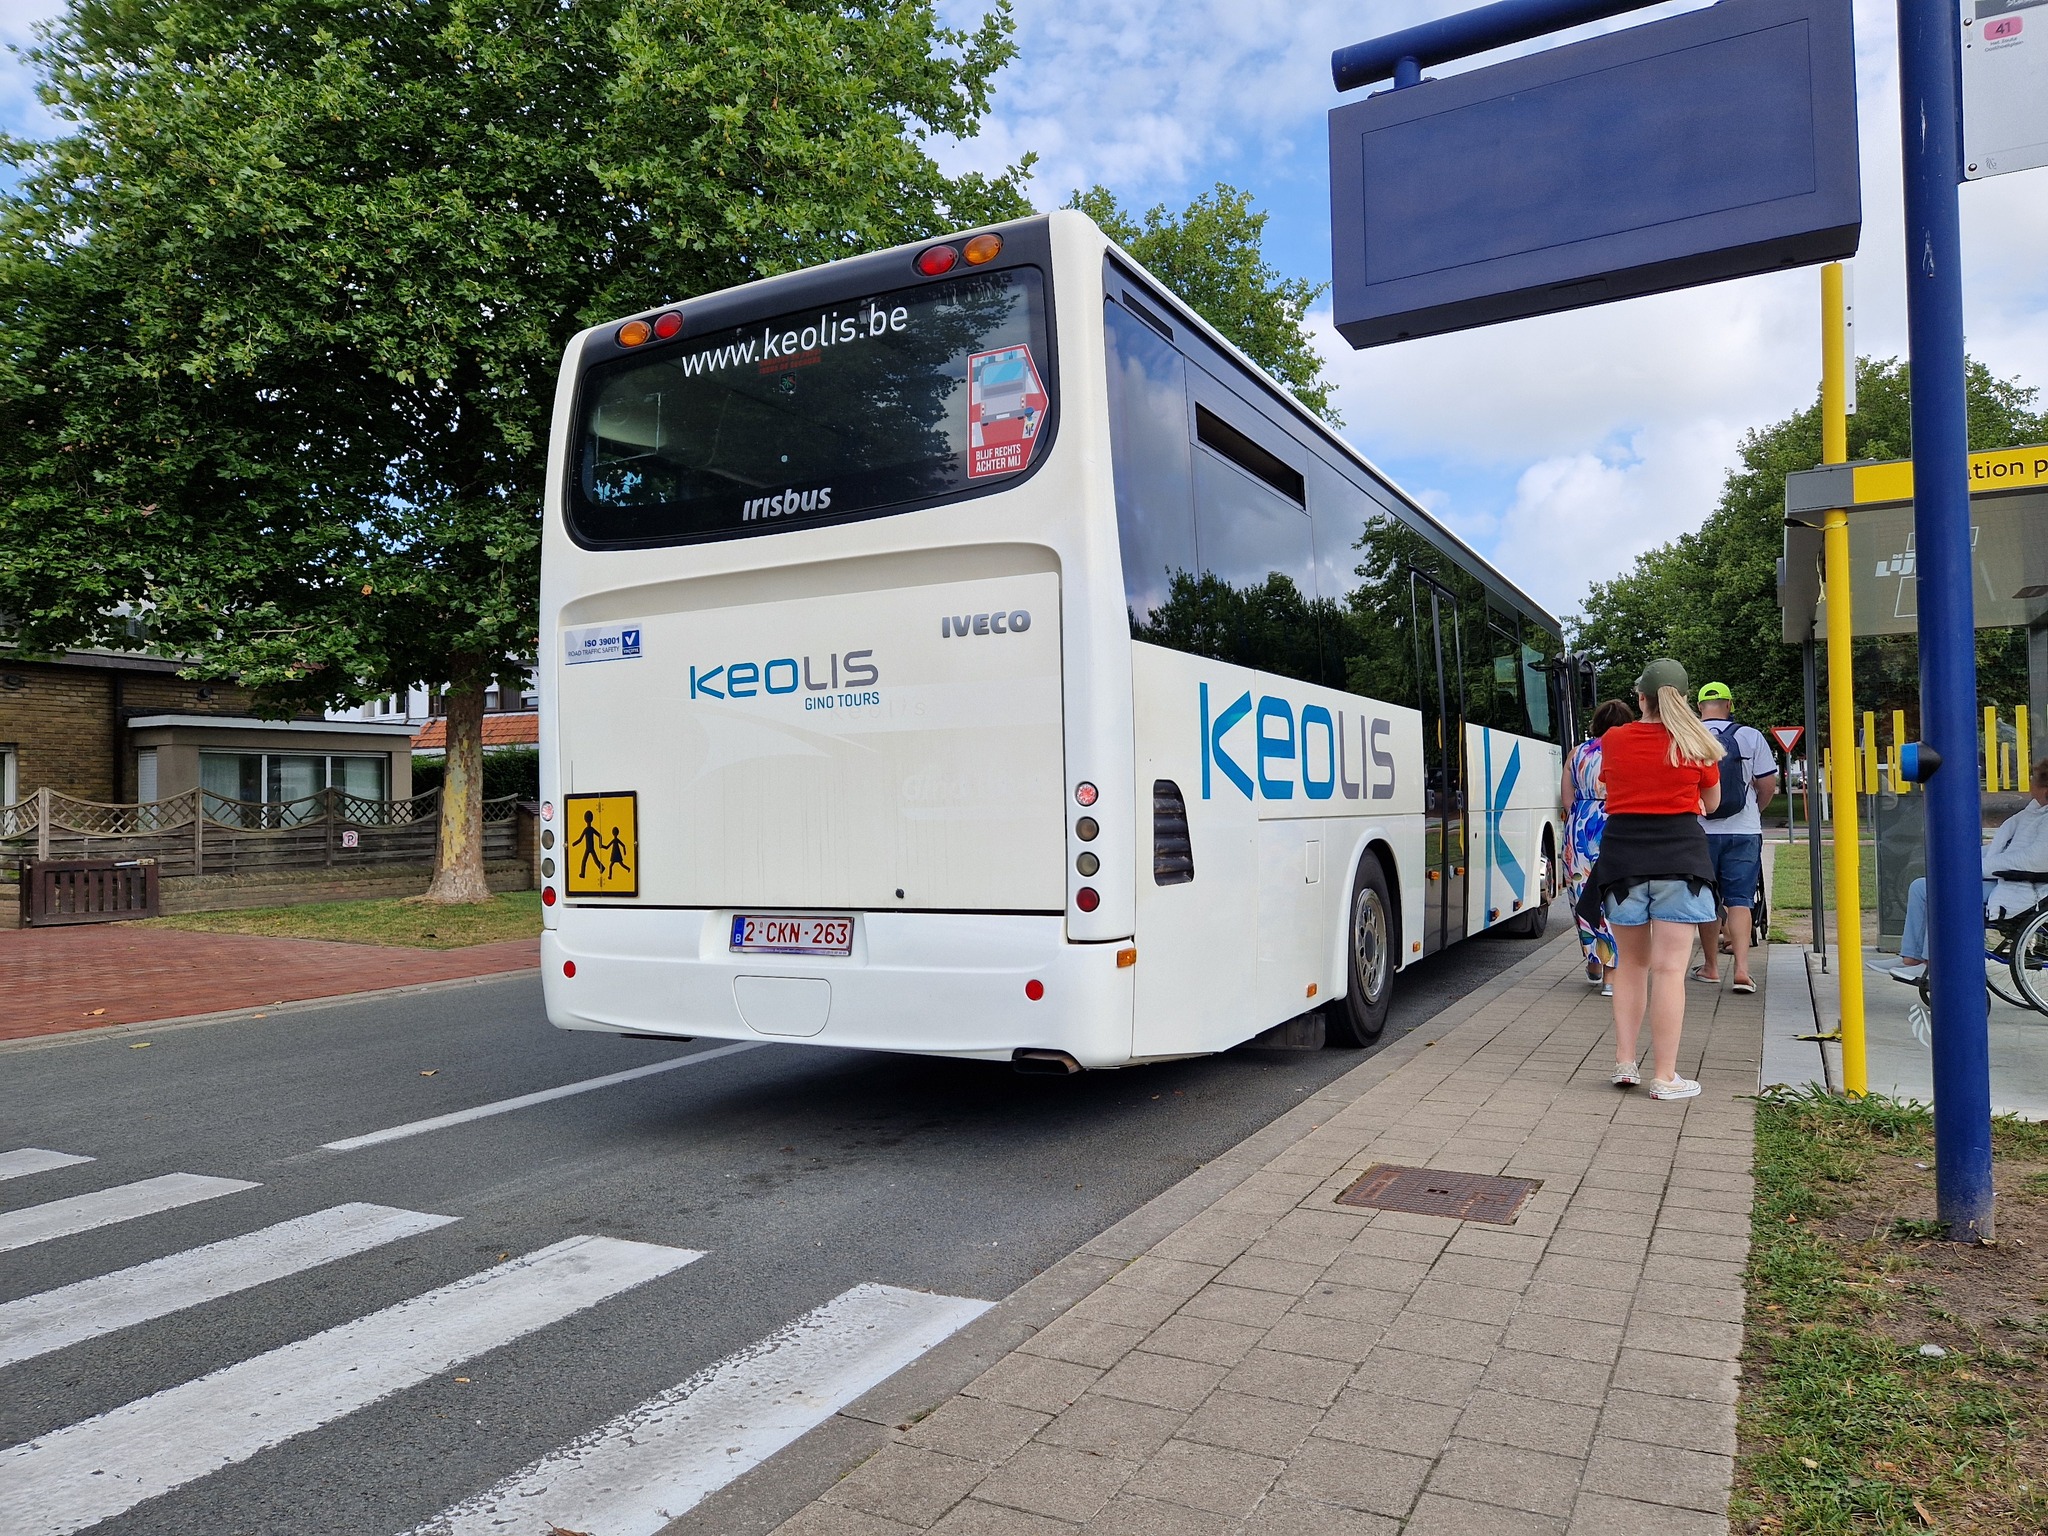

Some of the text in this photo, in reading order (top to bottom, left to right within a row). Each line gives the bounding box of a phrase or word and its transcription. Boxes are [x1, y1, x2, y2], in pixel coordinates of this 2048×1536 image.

[1995, 21, 2011, 34] 41
[681, 303, 908, 378] www.keolis.be
[975, 443, 1021, 461] BLIJF RECHTS
[975, 455, 1021, 473] ACHTER MIJ
[1968, 460, 2024, 480] tion
[942, 609, 1031, 638] IVECO
[584, 636, 620, 647] ISO 39001
[582, 647, 602, 655] TRAFFIC
[804, 691, 880, 711] GINO TOURS
[734, 933, 742, 943] B
